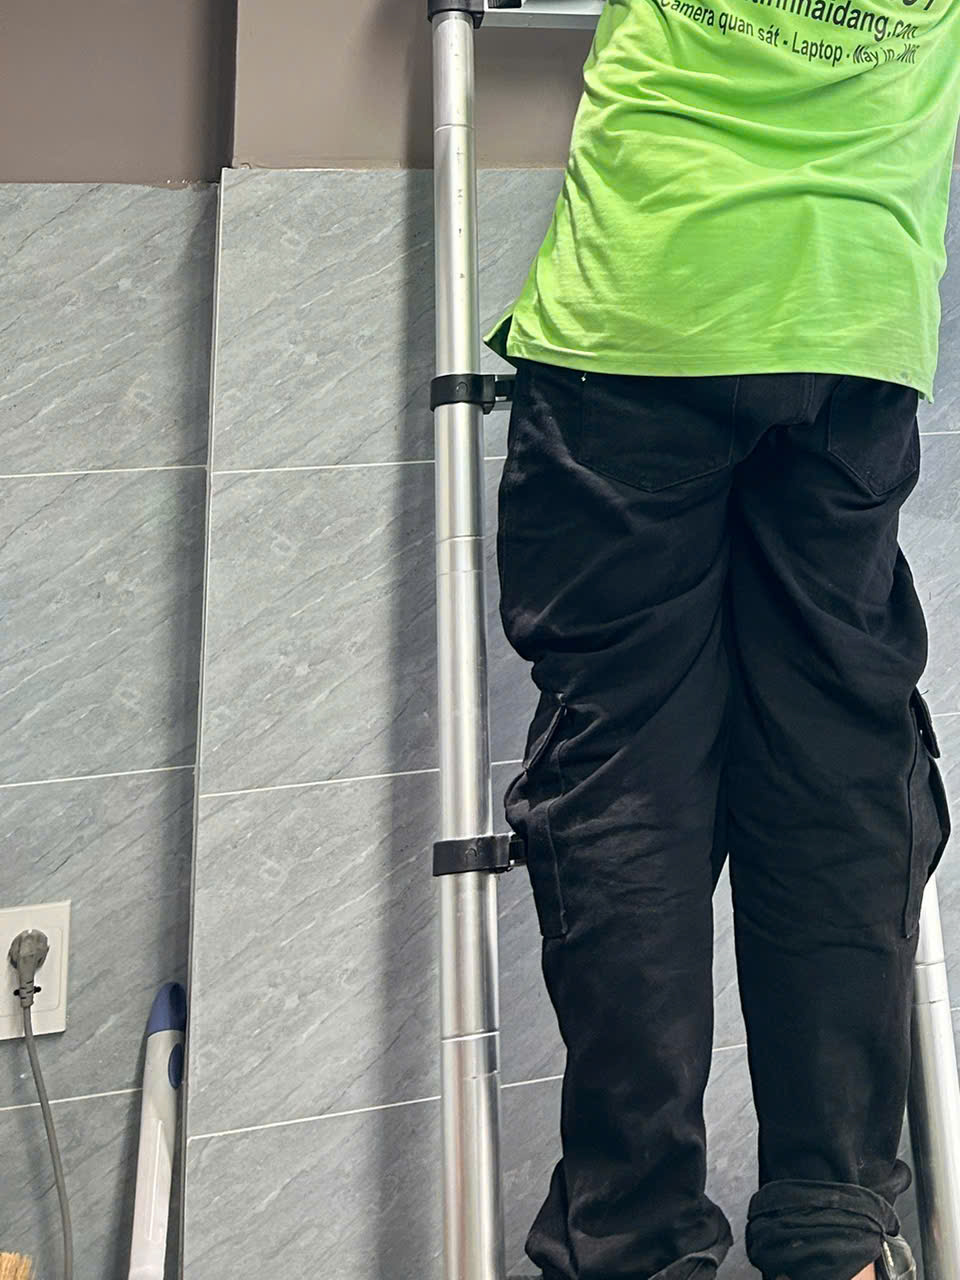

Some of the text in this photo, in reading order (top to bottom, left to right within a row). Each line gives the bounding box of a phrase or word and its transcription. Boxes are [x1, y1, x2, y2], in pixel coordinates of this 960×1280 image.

[719, 11, 754, 36] quan
[758, 24, 780, 48] sát
[791, 32, 842, 67] Laptop
